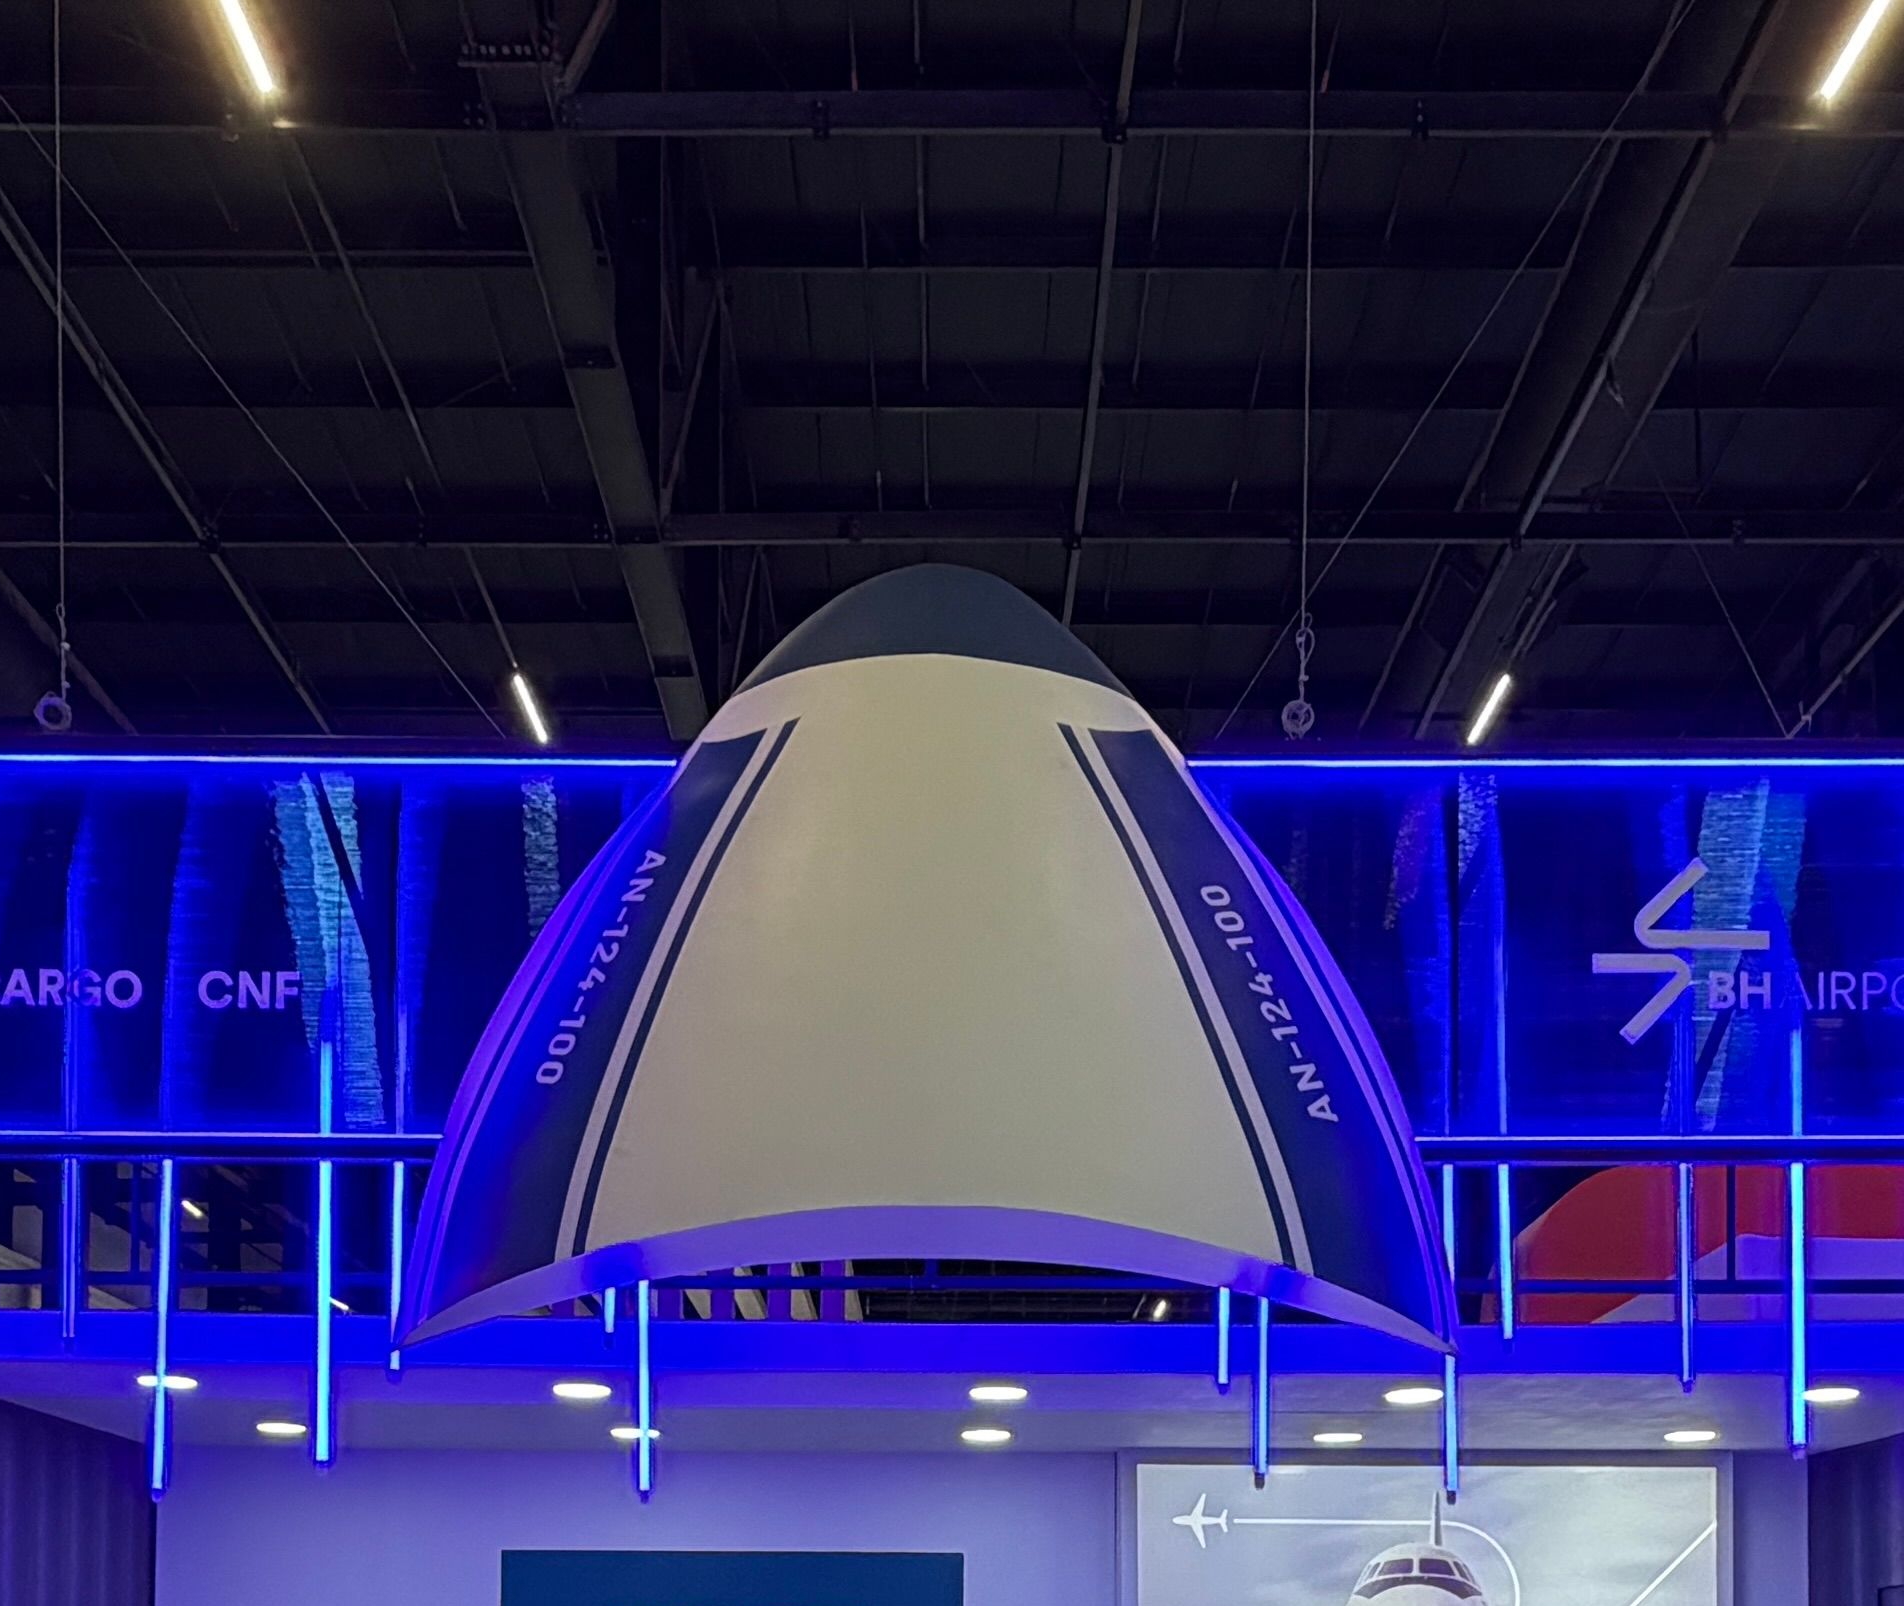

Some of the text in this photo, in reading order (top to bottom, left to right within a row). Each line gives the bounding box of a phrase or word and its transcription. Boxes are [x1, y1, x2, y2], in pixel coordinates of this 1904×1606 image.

[198, 970, 301, 1009] CNF
[536, 850, 667, 1084] AN-124-100
[1200, 885, 1339, 1122] AN-124-100
